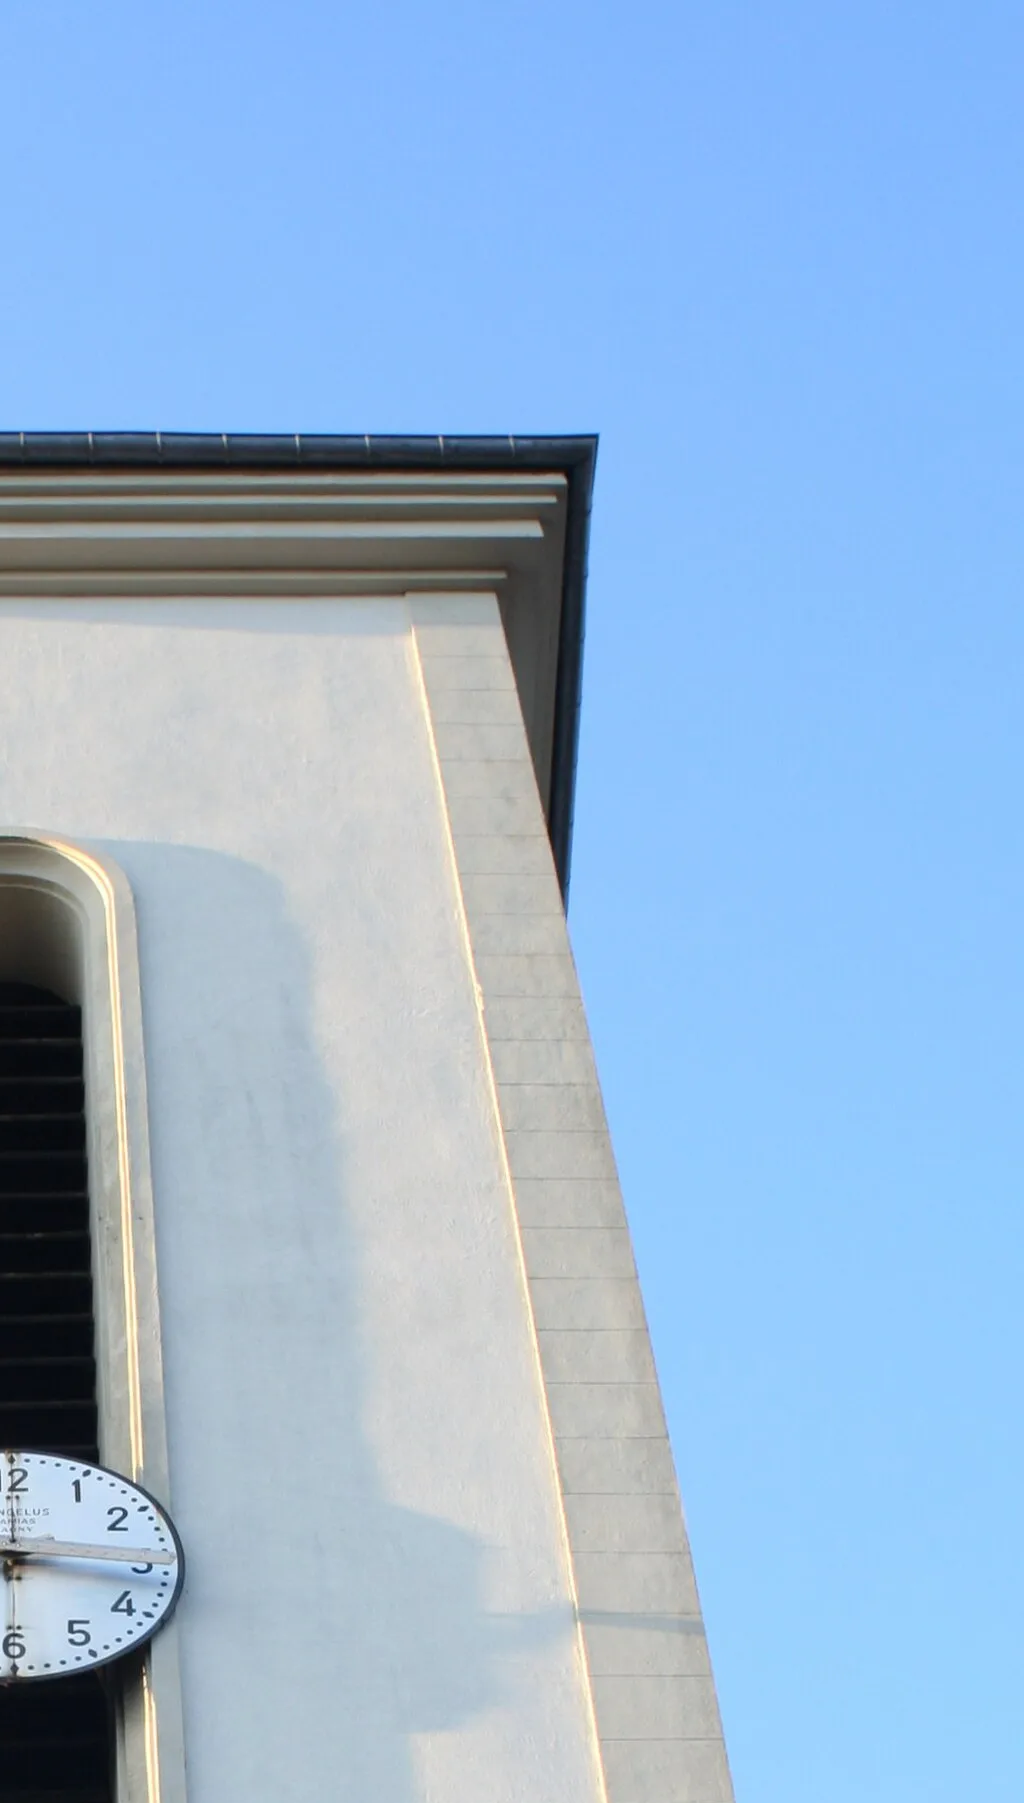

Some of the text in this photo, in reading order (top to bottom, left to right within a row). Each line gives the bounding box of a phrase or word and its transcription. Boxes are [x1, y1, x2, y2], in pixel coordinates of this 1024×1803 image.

[71, 1479, 81, 1503] 1
[107, 1506, 129, 1532] 2
[110, 1590, 137, 1617] 4
[2, 1632, 26, 1660] 6
[67, 1619, 91, 1646] 5
